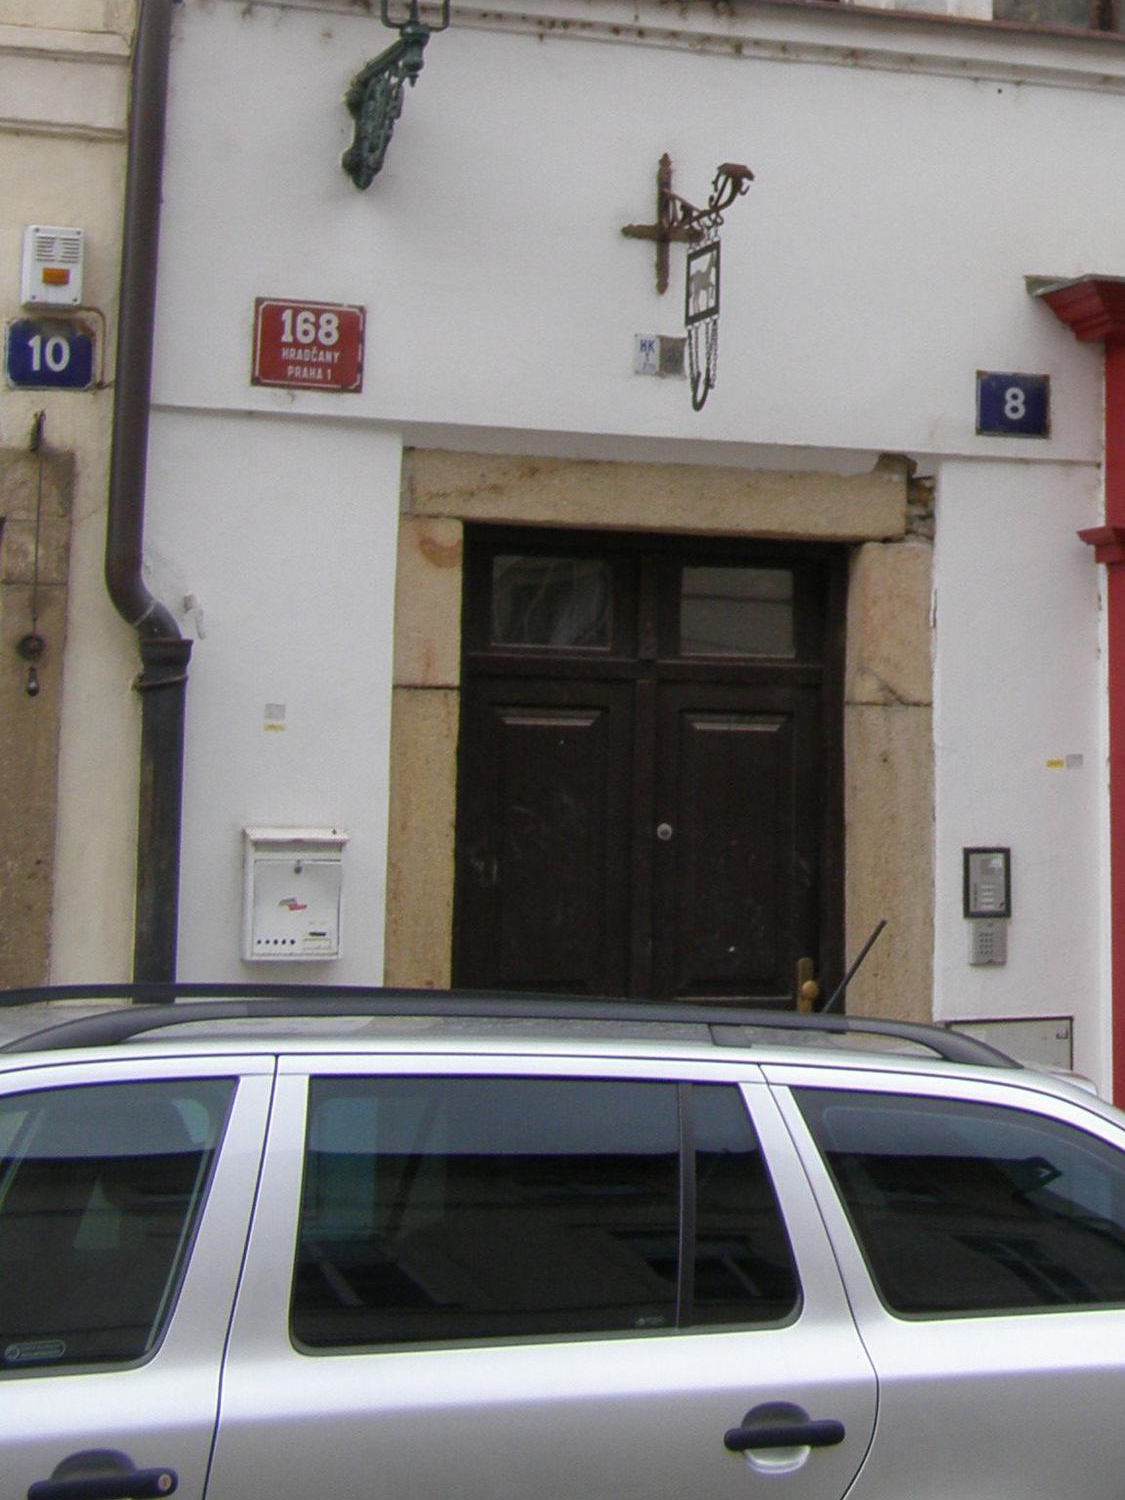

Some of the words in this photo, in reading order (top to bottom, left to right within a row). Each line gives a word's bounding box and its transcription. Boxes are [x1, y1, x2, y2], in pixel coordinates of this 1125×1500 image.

[281, 308, 339, 346] 168
[28, 334, 71, 373] 10
[281, 346, 340, 363] HRADČANY
[287, 365, 323, 380] PRAHA
[326, 369, 332, 380] 1
[1004, 387, 1025, 419] 8
